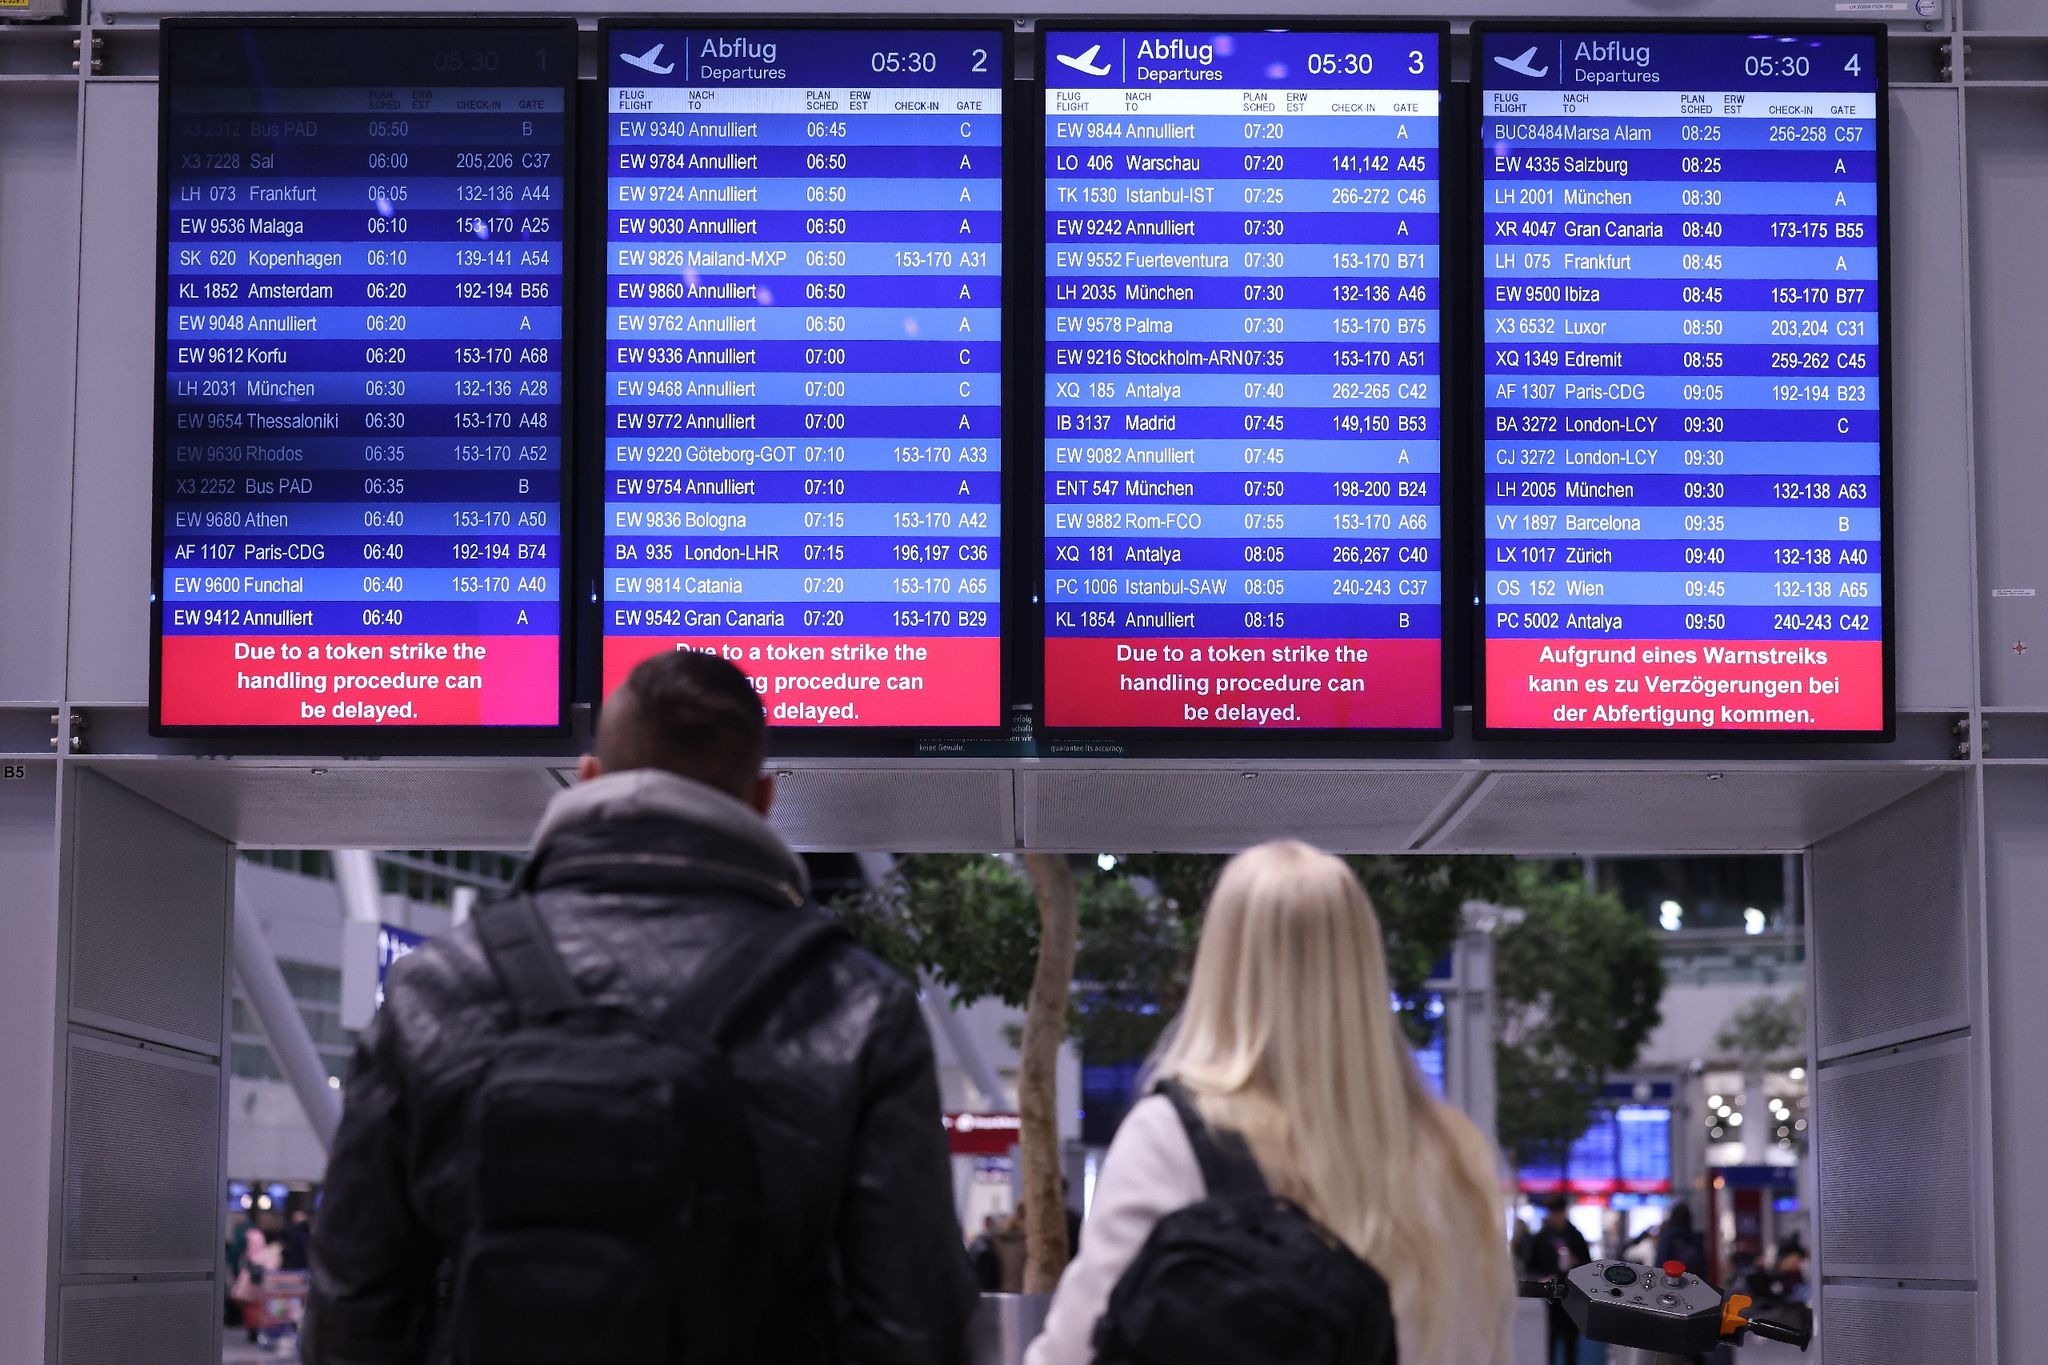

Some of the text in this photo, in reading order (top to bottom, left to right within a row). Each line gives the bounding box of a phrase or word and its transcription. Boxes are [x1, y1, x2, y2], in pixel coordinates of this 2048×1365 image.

[433, 47, 547, 73] 05:30 1
[700, 37, 777, 64] Abflug
[1137, 38, 1213, 66] Abflug
[1574, 40, 1650, 67] Abflug
[871, 48, 987, 73] 05:30 2
[1308, 50, 1425, 75] 05:30 3
[1745, 53, 1861, 77] 05:30 4
[701, 65, 786, 83] Departures
[1137, 66, 1223, 84] Departures
[1575, 68, 1660, 86] Departures
[619, 90, 871, 100] FLUG NACH PLAN ERW
[1056, 91, 1308, 102] FLUG NACH PLAN ERW
[1494, 93, 1745, 104] FLUG NACH PLAN ERW
[619, 100, 982, 111] FLIGHT TO SCHED EST CHECK-IN GATE
[1056, 101, 1419, 113] FLIGHT TO SCHED EST CHECK-IN GATE
[1494, 103, 1856, 115] FLIGHT TO SCHED EST CHECK-IN GATE
[1057, 186, 1427, 205] TK 1530 Istanbul-IST 07:25 266-272 C46
[180, 249, 550, 270] SK 620 Kopenhagen 06:10 139-141 A54
[1057, 251, 1424, 269] EW 9552 Fuerteventura 07:30 153-170 B71
[179, 282, 549, 299] KL 1852 Amsterdam 06:20 192-194 B56
[1495, 317, 1864, 338] X3 6532 Luxor 08:50 203,204 C31
[617, 347, 971, 365] EW 9336 Annulliert 07:00 C
[617, 445, 987, 466] EW 9220 Göteborg-GOT 07:10 153-170 A33
[1056, 479, 1427, 497] ENT 547 München 07:50 198-200 B24
[174, 543, 547, 560] AF 1107 Paris-CDG 06:40 192-194 B74
[616, 543, 988, 563] BA 935 London-LHR 07:15 196,197 C36
[1497, 546, 1868, 565] LX 1017 Zürich 09:40 132-138 A40
[234, 642, 486, 660] Due to a token strike the
[1117, 644, 1368, 663] Due to a token strike the
[1539, 645, 1828, 668] Aufgrund eines Warnstreiks
[237, 671, 482, 694] handling procedure can
[1120, 674, 1365, 696] handling procedure can
[1529, 674, 1839, 698] kann es zu Verzögerungen bei
[301, 701, 418, 723] be delayed.
[1184, 703, 1301, 725] be delayed.
[1553, 704, 1815, 727] der Abfertigung kommen.
[919, 743, 938, 752] keine
[4, 765, 24, 779] B5
